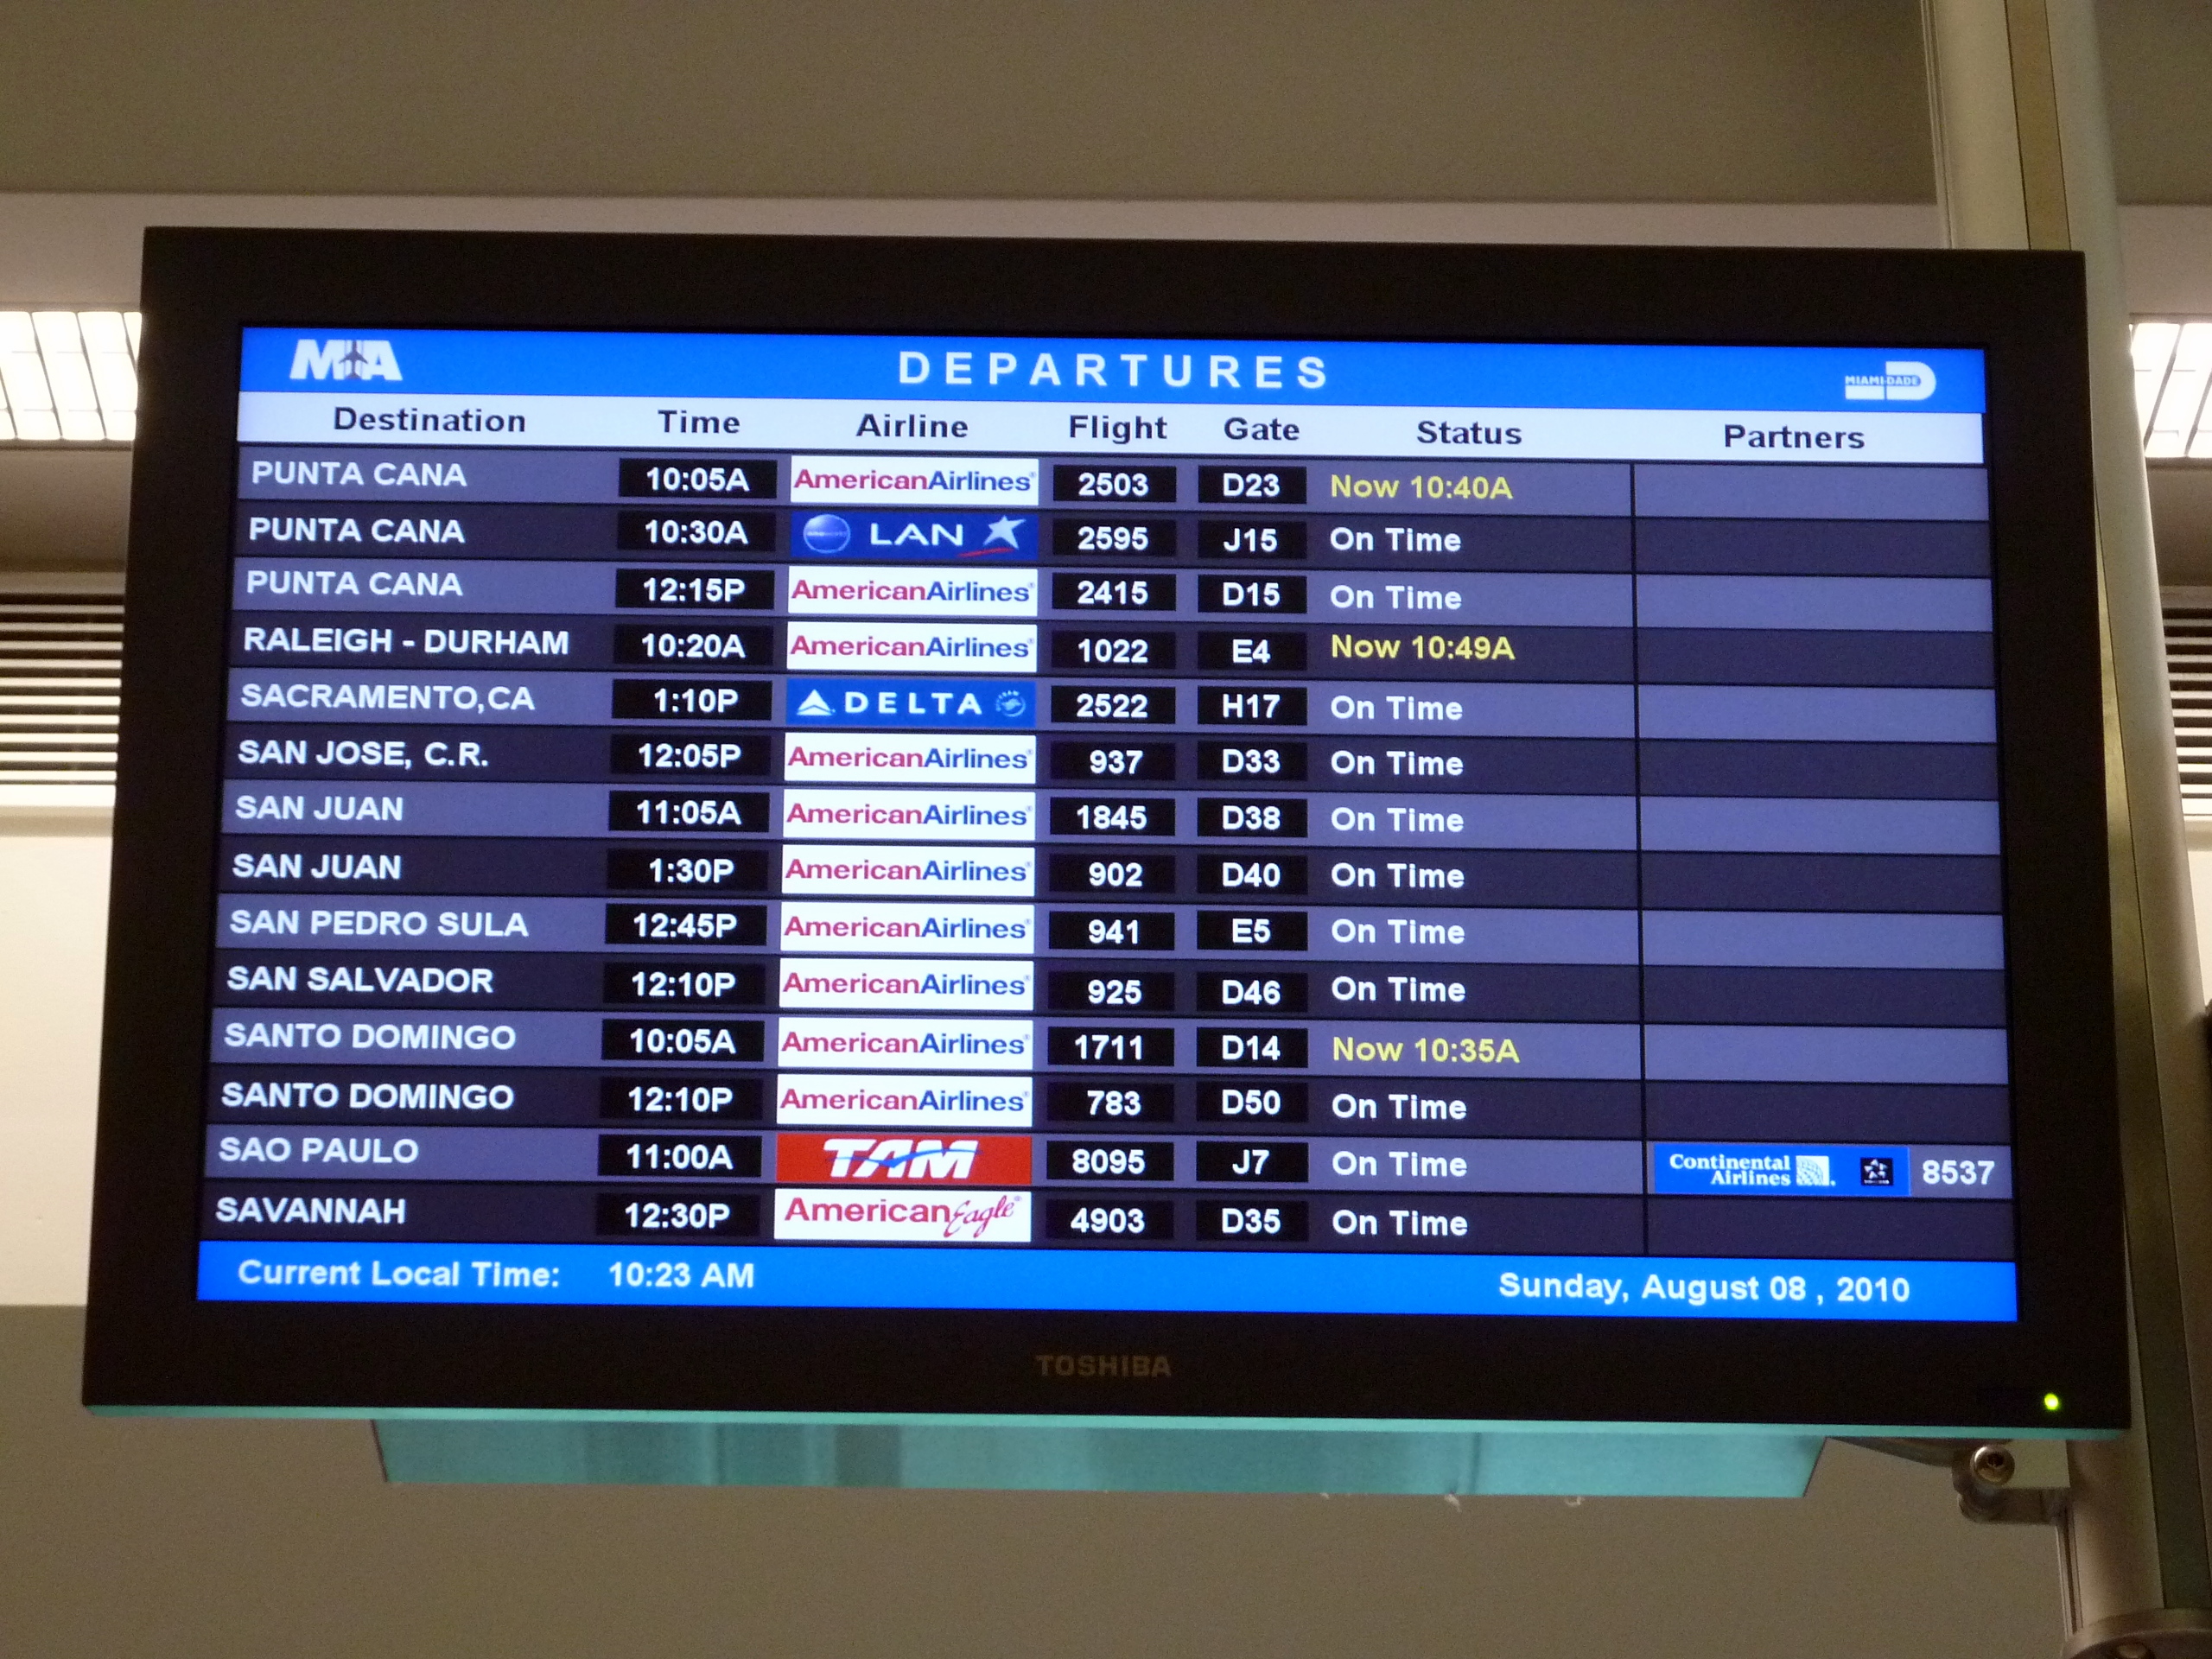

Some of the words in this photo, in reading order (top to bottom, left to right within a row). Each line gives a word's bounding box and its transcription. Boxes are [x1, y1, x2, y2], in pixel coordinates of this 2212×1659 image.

[899, 352, 1325, 389] DEPARTURES
[334, 407, 524, 432] Destination
[658, 410, 740, 433] Time
[856, 414, 968, 437] Airline
[1071, 416, 1166, 444] Flight
[1224, 417, 1300, 441] Gate
[1417, 421, 1522, 444] Status
[1725, 425, 1864, 448] Partners
[252, 461, 364, 485] PUNTA
[374, 462, 467, 486] CANA
[647, 467, 749, 492] 10:05A
[1079, 473, 1148, 496] 2503
[1224, 473, 1280, 497] D23
[1332, 474, 1399, 498] Now
[1411, 476, 1513, 499] 10:40A
[250, 518, 362, 542] PUNTA
[372, 519, 465, 543] CANA
[645, 520, 748, 544] 10:30A
[871, 524, 963, 546] LAN
[1078, 526, 1148, 550] 2595
[1224, 528, 1277, 552] J15
[1331, 527, 1373, 550] On
[1385, 528, 1461, 552] Time
[247, 570, 359, 594] PUNTA
[369, 572, 463, 596] CANA
[644, 578, 745, 602] 12:15P
[1077, 581, 1147, 605] 2415
[1224, 582, 1280, 607] D15
[1331, 585, 1373, 608] On
[1385, 586, 1461, 609] Time
[245, 627, 391, 652] RALEIGH
[424, 630, 569, 654] DURHAM
[642, 633, 746, 658] 10:20A
[1078, 639, 1147, 663] 1022
[1233, 639, 1270, 663] E4
[1332, 634, 1401, 658] Now
[1412, 636, 1515, 659] 10:49A
[241, 683, 535, 714] SACRAMENTO,CA
[655, 689, 738, 713] 1:10P
[845, 692, 982, 715] DELTA
[1077, 694, 1147, 718] 2522
[1223, 694, 1280, 718] H17
[1332, 696, 1374, 719] On
[1386, 696, 1462, 721] Time
[238, 740, 307, 764] SAN
[316, 741, 411, 769] JOSE,
[425, 742, 488, 766] C.R.
[639, 743, 741, 768] 12:05P
[1090, 750, 1143, 774] 937
[1223, 749, 1280, 773] D33
[1332, 750, 1375, 774] On
[1387, 751, 1463, 776] Time
[236, 796, 304, 819] SAN
[314, 797, 403, 821] JUAN
[638, 800, 741, 825] 11:05A
[1077, 805, 1147, 830] 1845
[1223, 805, 1280, 830] D38
[1332, 807, 1375, 831] On
[1387, 808, 1464, 832] Time
[232, 854, 302, 878] SAN
[311, 855, 401, 880] JUAN
[650, 858, 734, 883] 1:30P
[1090, 862, 1142, 887] 902
[1223, 862, 1281, 887] D40
[1332, 862, 1375, 887] On
[1387, 863, 1464, 888] Time
[230, 910, 299, 934] SAN
[311, 911, 427, 936] PEDRO
[438, 912, 529, 937] SULA
[634, 912, 737, 938] 12:45P
[1089, 919, 1138, 944] 941
[1232, 918, 1270, 943] E5
[1332, 918, 1376, 943] On
[1388, 919, 1465, 944] Time
[227, 966, 296, 991] SAN
[308, 967, 493, 993] SALVADOR
[632, 972, 735, 997] 12:10P
[1088, 980, 1141, 1004] 925
[1332, 976, 1376, 1001] On
[1388, 976, 1465, 1002] Time
[1223, 980, 1281, 1005] D46
[225, 1023, 341, 1048] SANTO
[353, 1024, 516, 1050] DOMINGO
[631, 1028, 736, 1053] 10:05A
[1075, 1035, 1141, 1060] 1711
[1223, 1035, 1281, 1060] D14
[1333, 1037, 1403, 1061] Now
[1415, 1038, 1520, 1063] 10:35A
[222, 1082, 339, 1108] SANTO
[350, 1084, 514, 1109] DOMINGO
[629, 1087, 733, 1112] 12:10P
[1088, 1090, 1141, 1116] 783
[1223, 1090, 1281, 1115] D50
[1332, 1094, 1376, 1118] On
[1389, 1094, 1466, 1120] Time
[219, 1137, 291, 1162] SAO
[302, 1138, 418, 1163] PAULO
[627, 1144, 734, 1169] 11:00A
[823, 1140, 979, 1179] TAM
[1072, 1149, 1145, 1174] 8095
[1232, 1149, 1269, 1174] J7
[1669, 1153, 1791, 1171] Continental
[1332, 1151, 1376, 1175] On
[1389, 1152, 1466, 1177] Time
[1923, 1160, 1994, 1185] 8537
[1710, 1172, 1792, 1186] Airlines
[216, 1197, 405, 1224] SAVANNAH
[626, 1203, 730, 1229] 12:30P
[1071, 1208, 1145, 1233] 4903
[1223, 1208, 1281, 1234] D35
[1332, 1210, 1377, 1235] On
[1389, 1211, 1467, 1236] Time
[238, 1259, 361, 1285] Current
[372, 1261, 459, 1286] Local
[472, 1262, 559, 1287] Time:
[610, 1262, 690, 1287] 10:23
[701, 1262, 753, 1287] AM
[1499, 1272, 1628, 1305] Sunday,
[1642, 1274, 1758, 1306] August
[1770, 1276, 1806, 1300] 08
[1837, 1277, 1910, 1302] 2010
[1036, 1355, 1171, 1376] TOSHIBA
